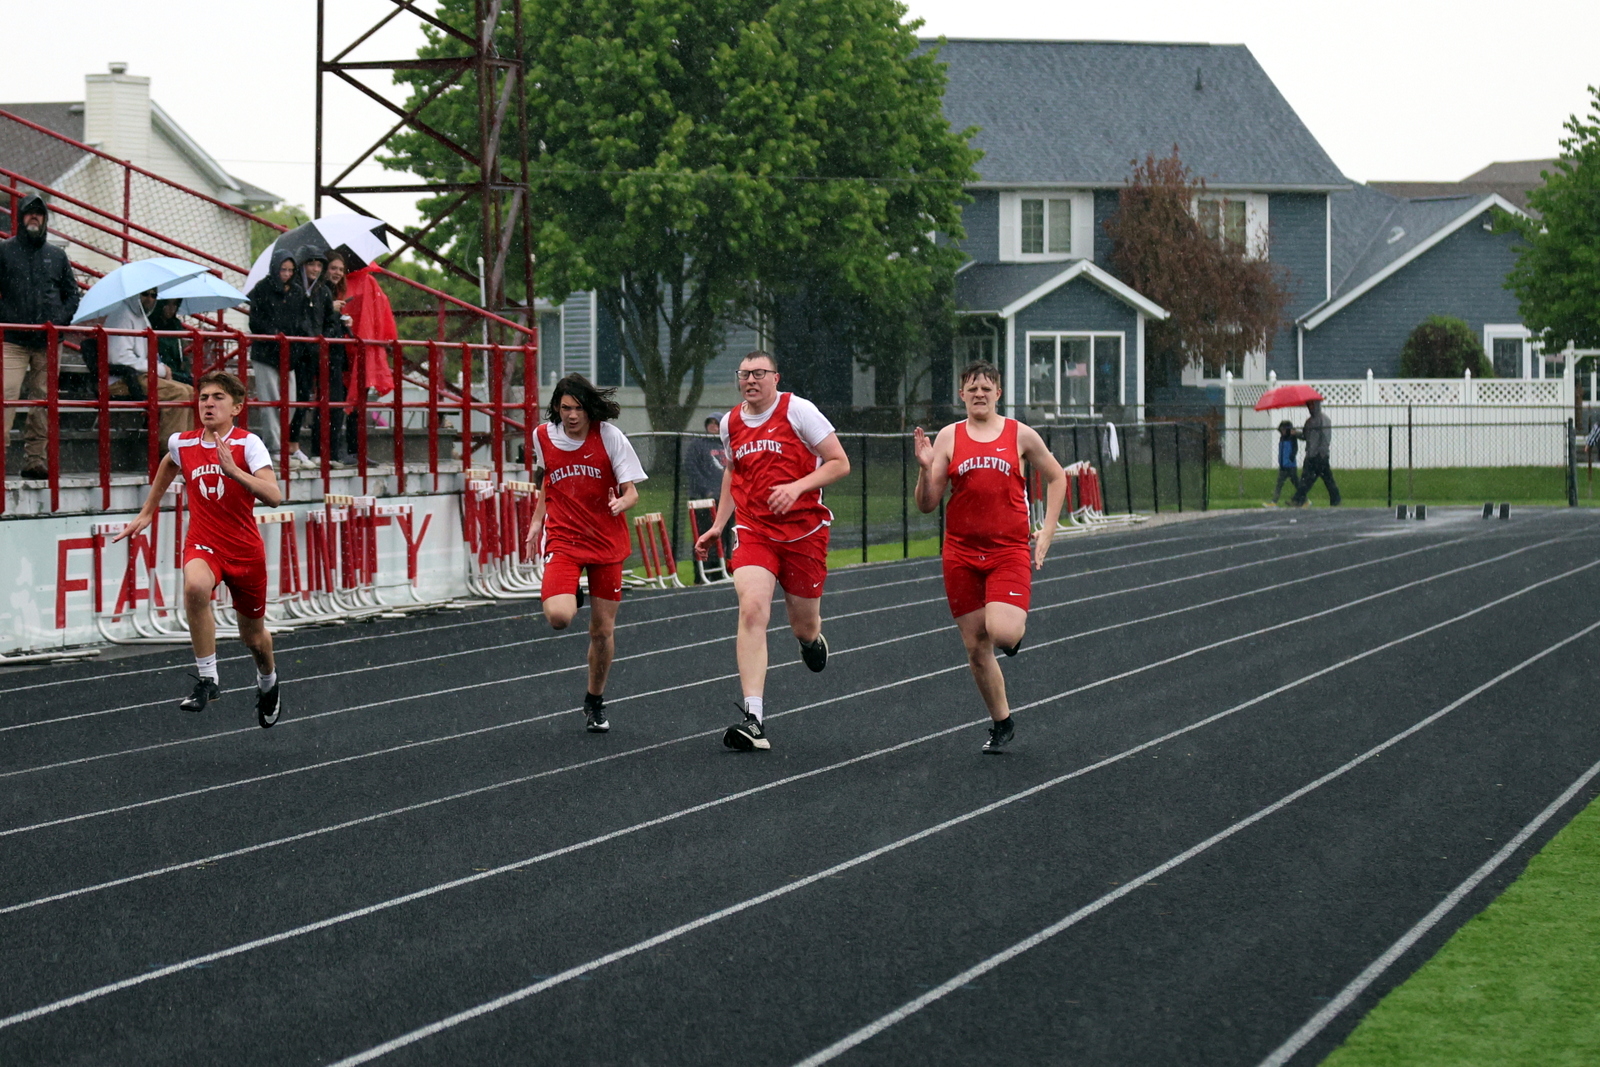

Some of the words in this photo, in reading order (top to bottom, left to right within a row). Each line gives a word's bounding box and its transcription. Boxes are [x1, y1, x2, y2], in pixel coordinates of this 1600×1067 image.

[735, 438, 783, 460] BELLEVUE
[191, 463, 227, 481] BELLEV
[549, 464, 602, 485] BELLEVUE
[958, 456, 1012, 477] BELLEVUE
